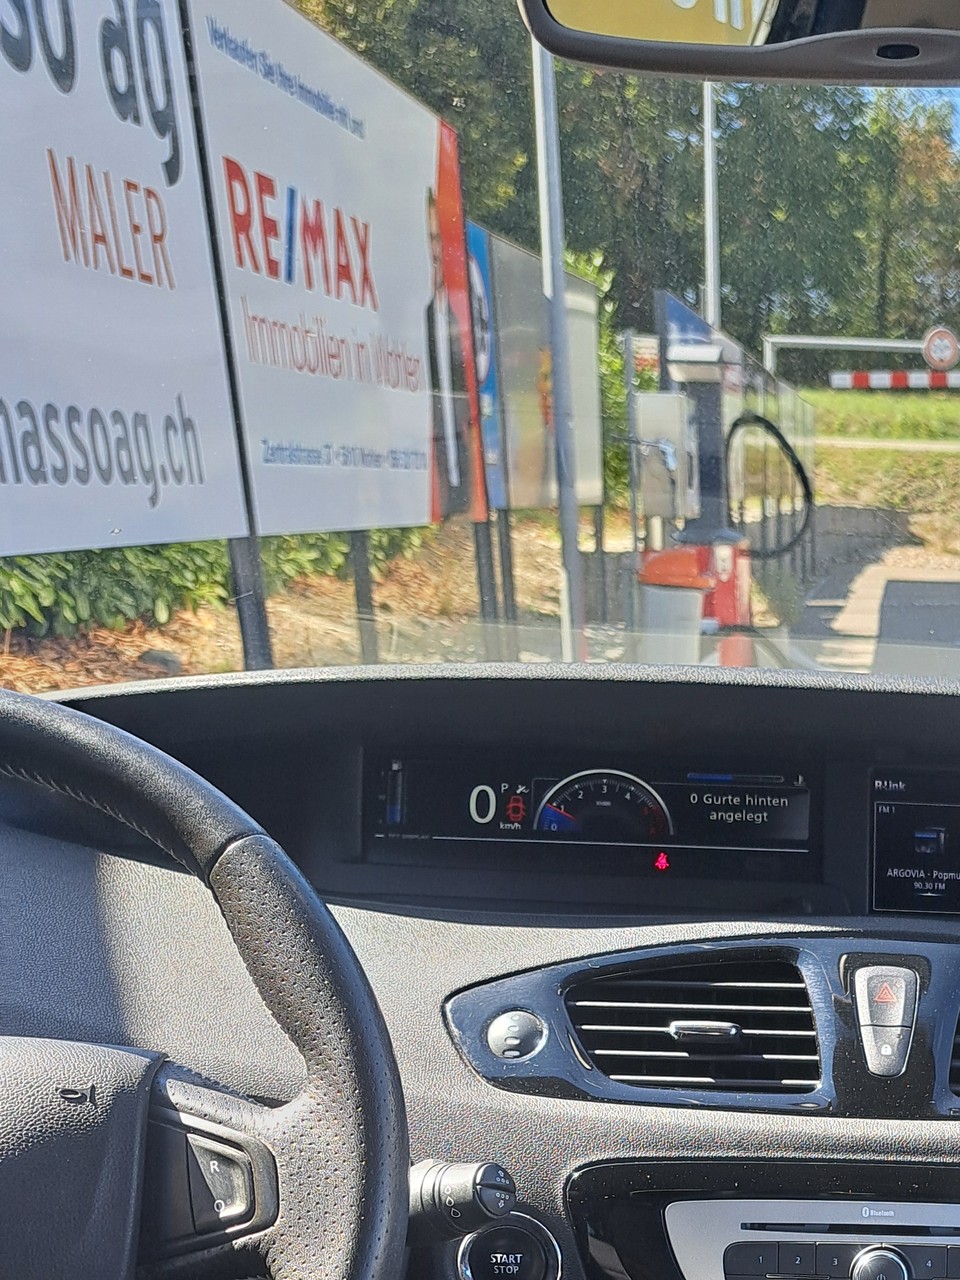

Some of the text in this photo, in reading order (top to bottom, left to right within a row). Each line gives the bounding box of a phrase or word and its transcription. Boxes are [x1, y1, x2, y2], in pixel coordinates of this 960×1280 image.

[47, 148, 176, 291] MALER
[222, 155, 380, 312] RE/MAX
[240, 296, 349, 380] Immobilien
[501, 783, 510, 793] P
[469, 785, 497, 824] 0
[690, 793, 789, 807] 0 Gurte hinten
[709, 811, 768, 823] angelegt
[500, 822, 522, 830] km/h
[887, 869, 925, 878] ARGOVIA
[913, 882, 946, 890] 90.30 FM
[209, 1161, 220, 1173] R
[870, 1209, 895, 1217] Bluetooth
[490, 1253, 523, 1264] START
[493, 1265, 520, 1275] STOP
